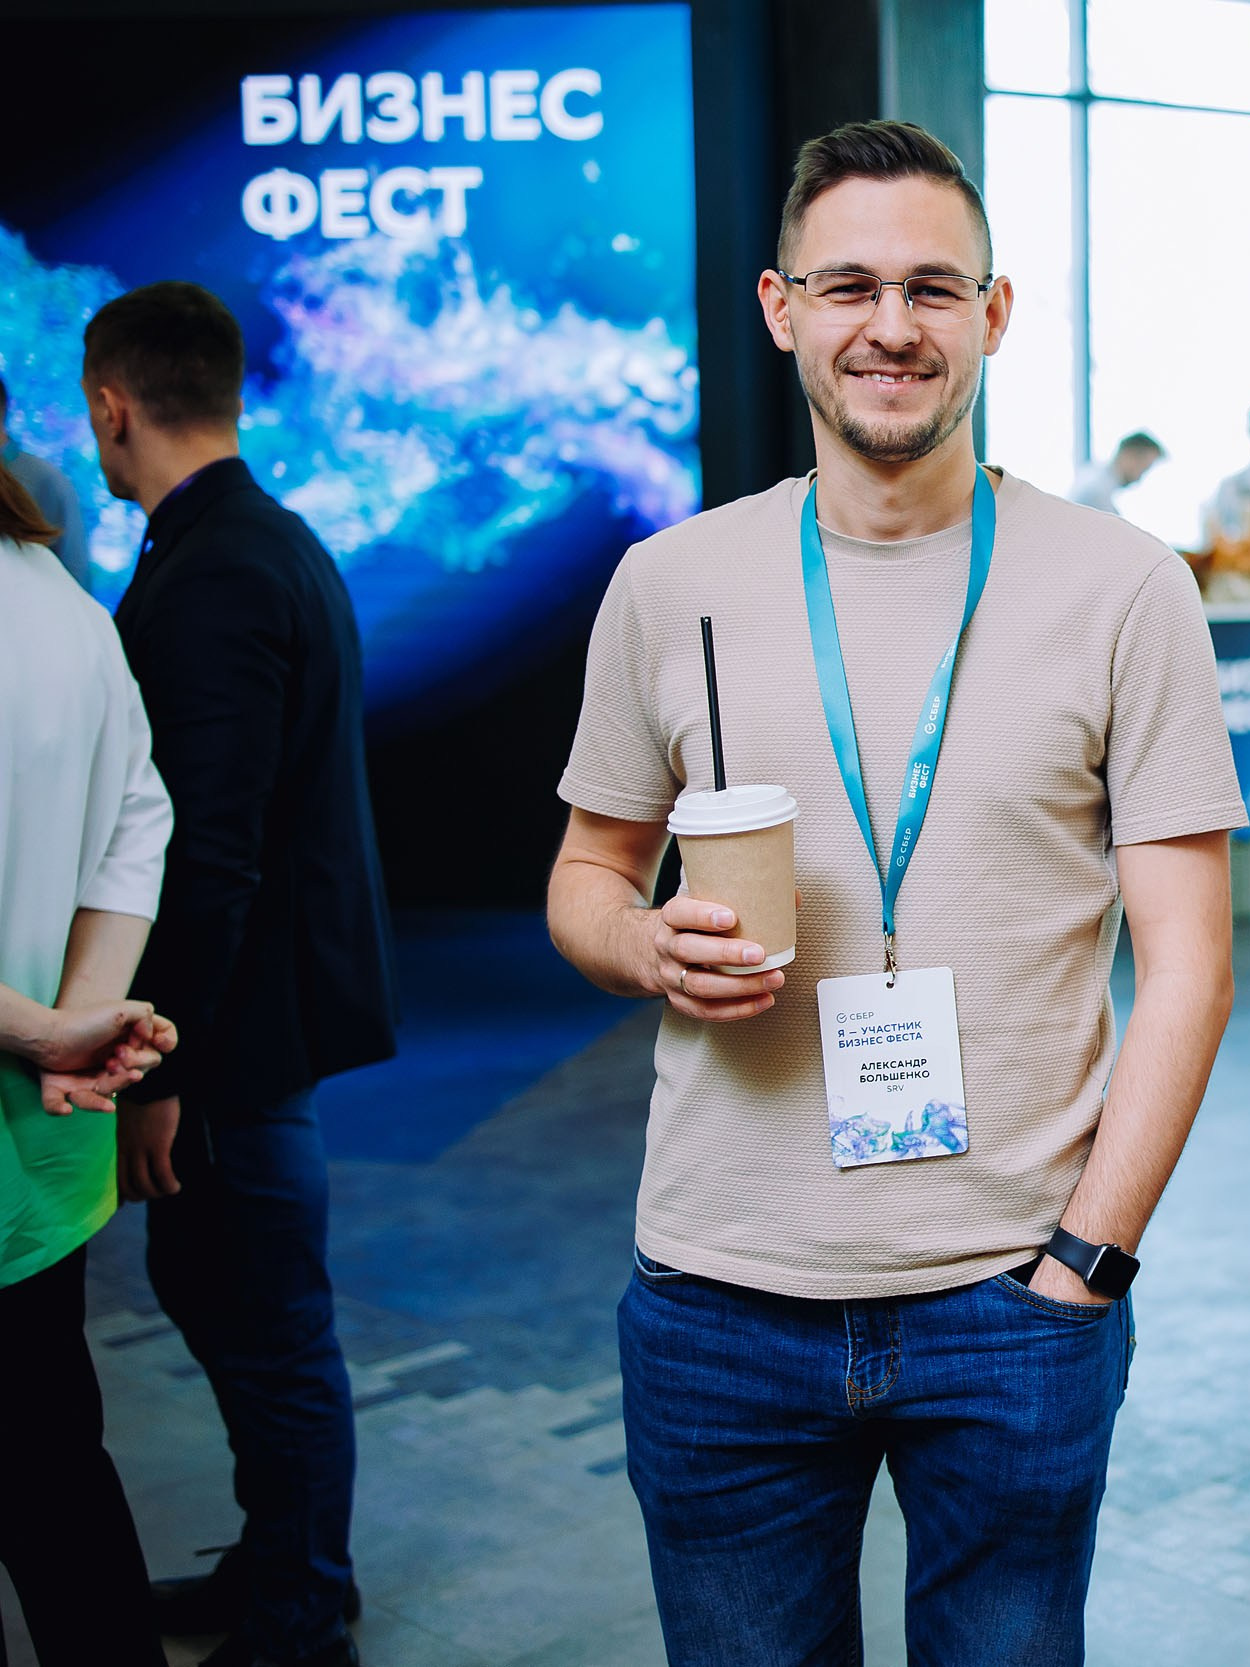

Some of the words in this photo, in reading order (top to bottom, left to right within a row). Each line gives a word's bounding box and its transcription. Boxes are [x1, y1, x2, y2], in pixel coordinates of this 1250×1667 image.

[241, 68, 603, 145] БИЗНЕС
[241, 166, 483, 240] ФЕСТ
[929, 695, 941, 721] СБЕР
[908, 762, 922, 799] БИЗНЕС
[919, 764, 931, 789] ФЕСТ
[900, 828, 912, 853] СБЕР
[849, 1011, 875, 1021] СБЕР
[837, 1029, 845, 1038] Я
[861, 1021, 923, 1035] УЧАСТНИК
[838, 1036, 884, 1049] БИЗНЕС
[886, 1032, 923, 1043] ФЕСТА
[860, 1058, 928, 1071] АЛЕКСАНДР
[859, 1070, 930, 1083] БОЛЬШЕНКО
[886, 1084, 905, 1093] SRV
